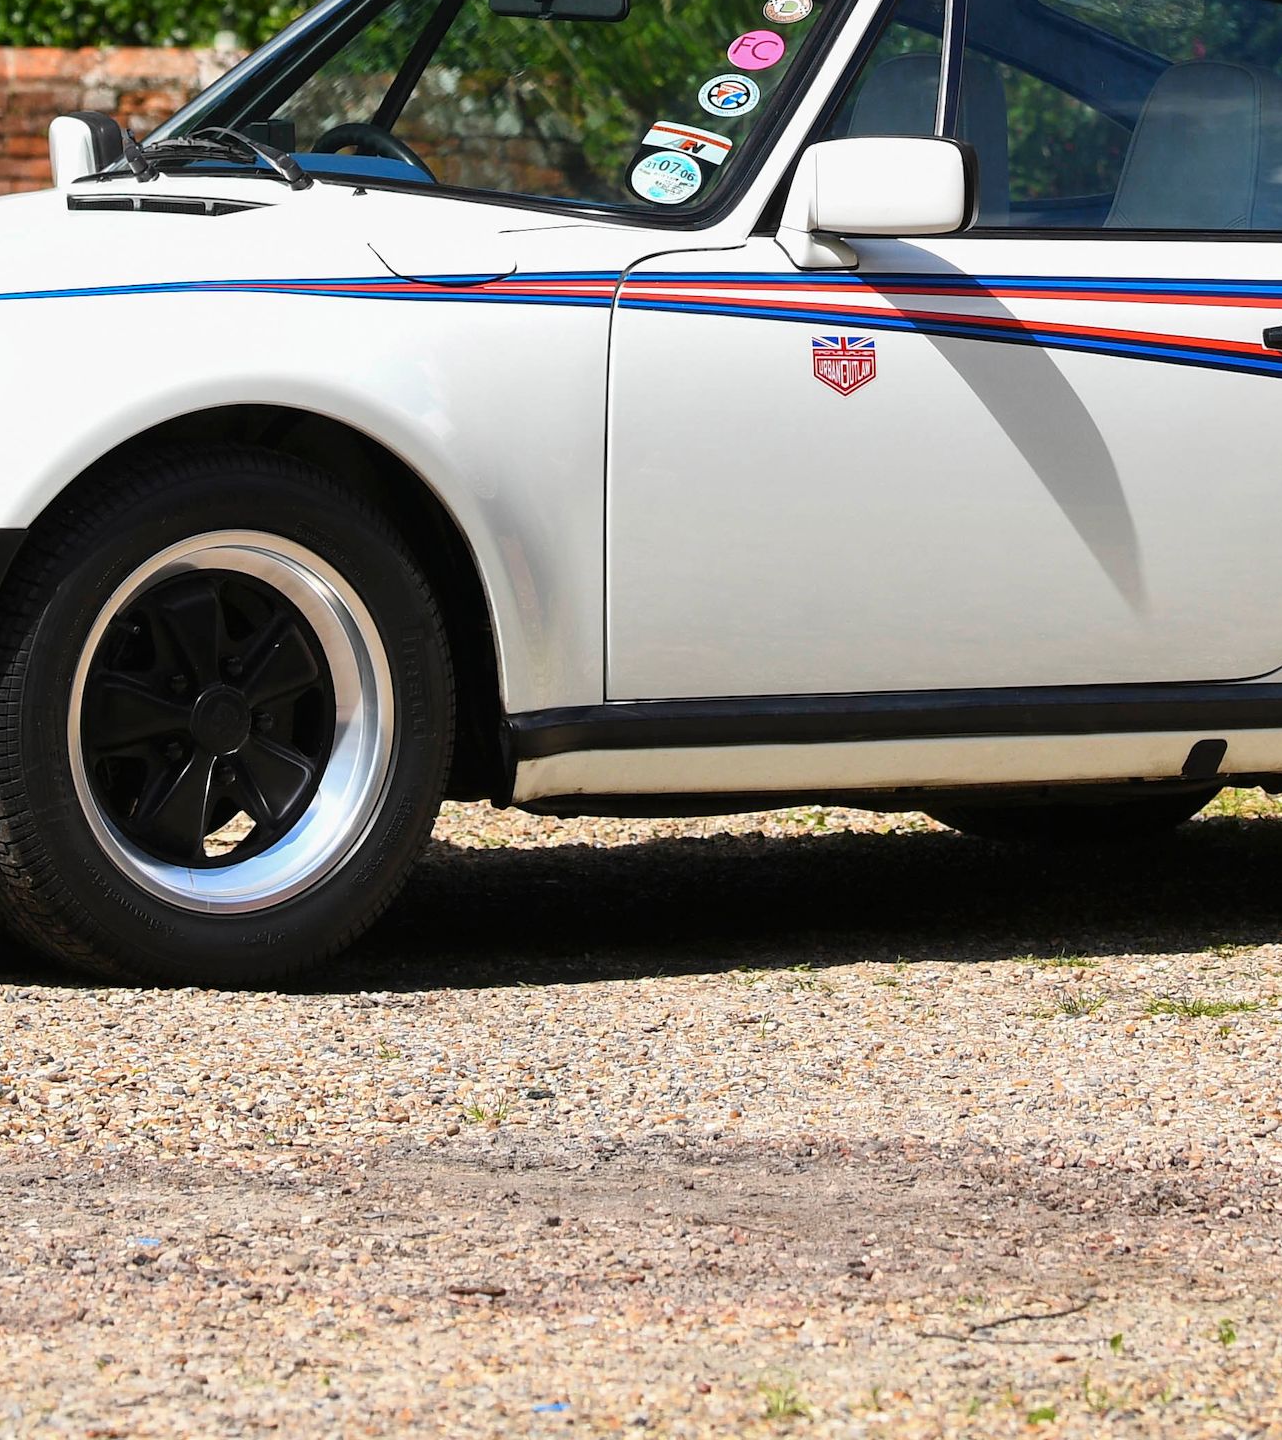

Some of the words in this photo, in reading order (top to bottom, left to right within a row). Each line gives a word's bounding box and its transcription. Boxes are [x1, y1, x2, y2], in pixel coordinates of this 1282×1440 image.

[732, 35, 779, 61] FC
[658, 159, 682, 174] 07
[680, 169, 696, 182] 06
